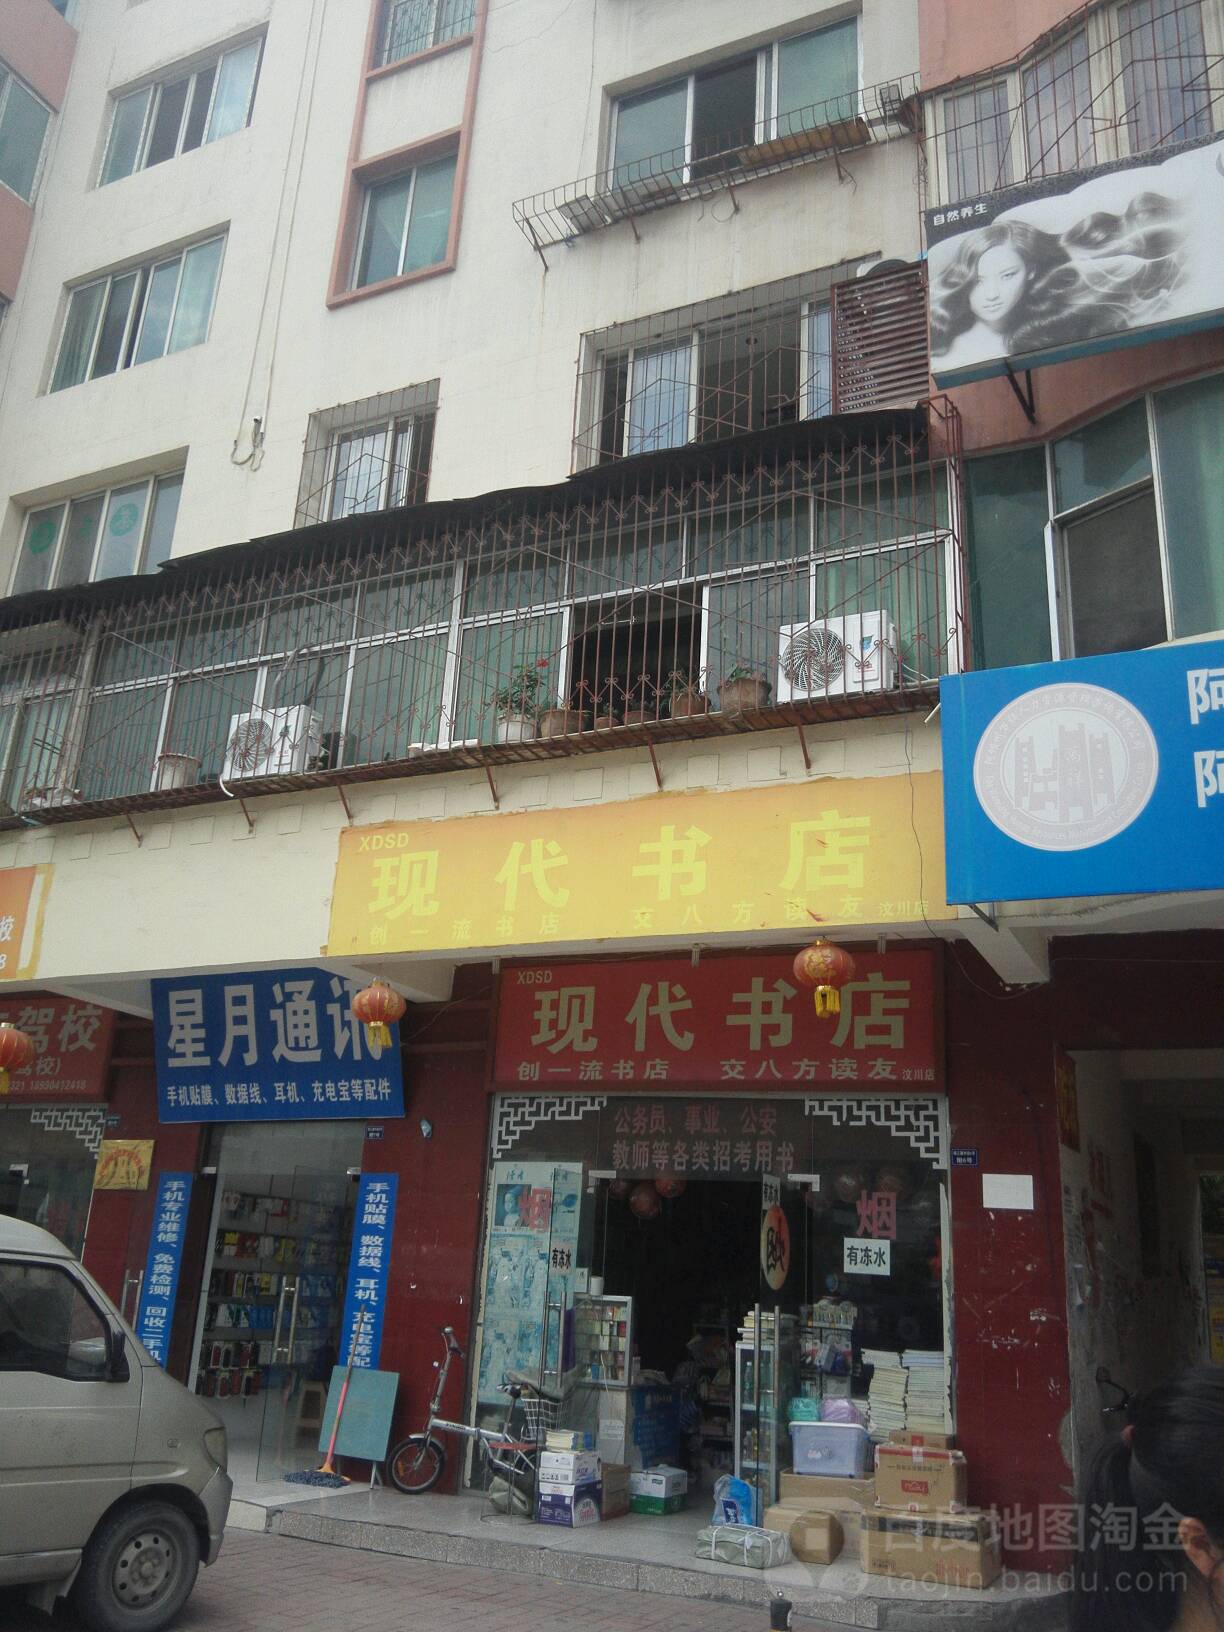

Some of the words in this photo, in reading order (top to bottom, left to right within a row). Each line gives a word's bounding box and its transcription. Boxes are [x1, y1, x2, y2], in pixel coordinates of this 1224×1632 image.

[933, 203, 988, 226] 自然养生
[358, 832, 409, 852] XDSD
[368, 810, 871, 921] 现代书店
[634, 895, 863, 929] 交八方读友
[370, 912, 560, 945] 创一流书店
[517, 970, 552, 985] XDSD
[531, 973, 912, 1054] 现代书店
[517, 1060, 670, 1081] 创一流书店
[720, 1058, 898, 1080] 交八方读友
[902, 1067, 936, 1081] 汶川店
[612, 1139, 795, 1172] 教师等各类招考用书
[856, 1189, 897, 1241] 烟
[846, 1246, 886, 1267] 有冻水
